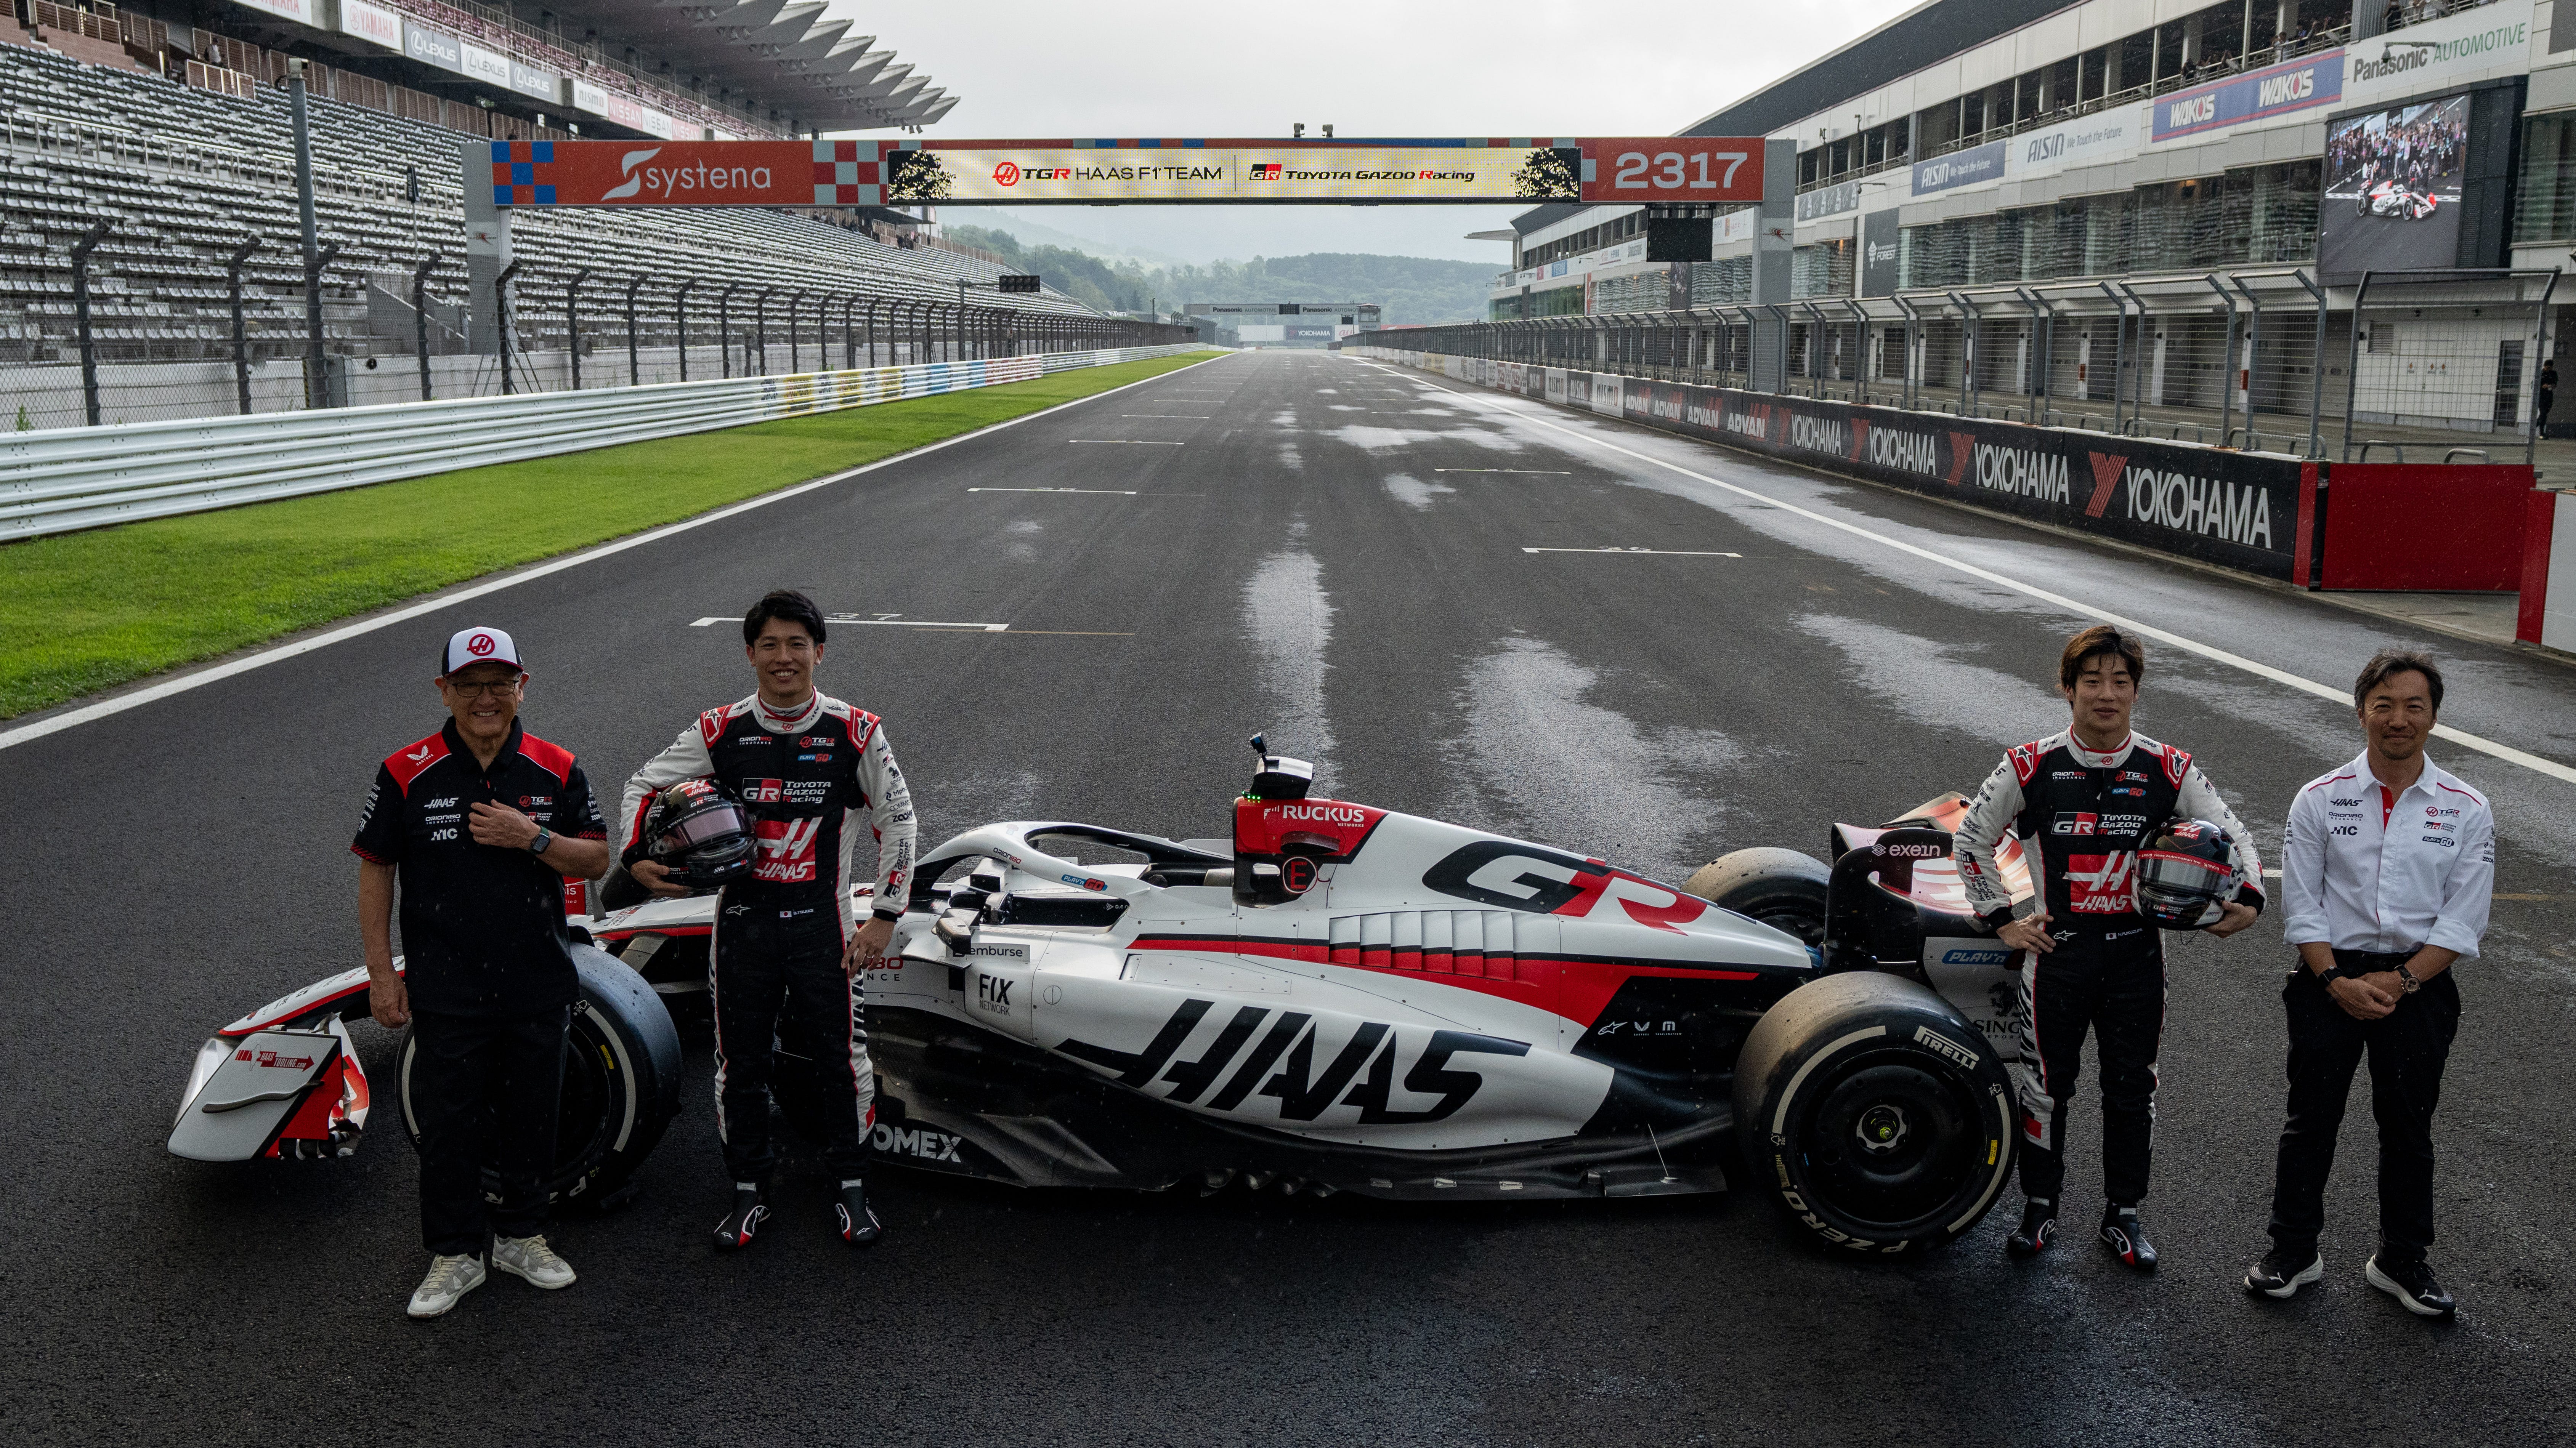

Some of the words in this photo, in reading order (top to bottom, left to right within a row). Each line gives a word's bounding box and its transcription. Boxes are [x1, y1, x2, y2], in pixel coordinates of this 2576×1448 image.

[360, 10, 394, 41] YAMAHA
[423, 43, 456, 62] LEXUS
[2354, 47, 2428, 82] Panasonic
[2433, 22, 2526, 63] AUTOMOTIVE
[477, 59, 505, 77] LEXUS
[523, 76, 549, 93] LEXUS
[579, 89, 604, 107] nismo
[610, 102, 642, 124] NISSAN
[642, 113, 671, 135] NISSAN
[673, 125, 699, 140] NISSAN
[2027, 133, 2064, 163] AISIN
[2067, 138, 2076, 148] We
[2076, 134, 2092, 146] Touch
[2093, 132, 2103, 143] the
[2103, 127, 2122, 140] Future
[646, 159, 771, 198] systena
[1022, 168, 1071, 179] TGR
[1076, 167, 1134, 180] HAAS
[1167, 167, 1222, 180] TEAM
[1250, 171, 1279, 181] GR
[1285, 170, 1351, 179] TOYOTA
[1355, 170, 1416, 179] GAZOO
[1419, 170, 1476, 182] Racing
[1615, 152, 1748, 189] 2317
[1921, 162, 1949, 188] AISIN
[1950, 167, 1957, 176] We
[1957, 165, 1969, 175] Touch
[1976, 159, 1990, 171] Future
[1877, 250, 1896, 261] FOREST
[1339, 328, 1353, 336] au
[1596, 384, 1618, 407] nismo
[1625, 394, 1648, 415] ADVAN
[1654, 399, 1680, 421] ADVAN
[1687, 406, 1719, 428] ADVAN
[1727, 413, 1766, 439] ADVAN
[1791, 415, 1841, 456] YOKOHAMA
[1869, 425, 1936, 476] YOKOHAMA
[1975, 443, 2069, 505] YOKOHAMA
[2126, 466, 2271, 549] YOKOHAMA
[2139, 739, 2157, 748] HAAS
[416, 754, 433, 766] CASTORE
[2125, 771, 2148, 779] TGR
[687, 788, 711, 797] HAAS
[743, 787, 780, 800] GR
[783, 796, 823, 804] Racing
[2129, 788, 2142, 796] GO
[423, 797, 459, 809] HAAS
[690, 799, 703, 807] GR
[2330, 798, 2363, 807] HAAS
[684, 813, 697, 821] Haas
[697, 804, 722, 816] Automation
[1283, 805, 1365, 823] RUCKUS
[2053, 821, 2093, 834] GR
[2097, 828, 2138, 837] Racing
[2174, 831, 2199, 839] HAAS
[2440, 838, 2452, 847] GO
[895, 838, 905, 868] TOYOTA
[2166, 854, 2193, 862] Automation
[753, 861, 816, 880] HAAS
[1959, 850, 1975, 875] GR
[1063, 876, 1084, 885] PLAY'n
[1087, 880, 1103, 889] GO
[1290, 860, 1308, 889] E
[889, 872, 906, 899] GR
[1422, 841, 1707, 936] GR
[1970, 876, 1985, 902] Racing
[1975, 876, 1991, 901] GAZOO
[1980, 877, 1997, 900] TOYOTA
[2071, 894, 2132, 911] HAAS
[970, 945, 1023, 957] emburse
[1944, 953, 2003, 963] PLAY'n
[979, 974, 1014, 1004] FIX
[979, 999, 1011, 1016] NETWORK
[1914, 1025, 1980, 1070] PIRELLI
[260, 1052, 275, 1062] HAAS
[1053, 998, 1533, 1124] HAAS
[1782, 1191, 1875, 1251] ZERO
